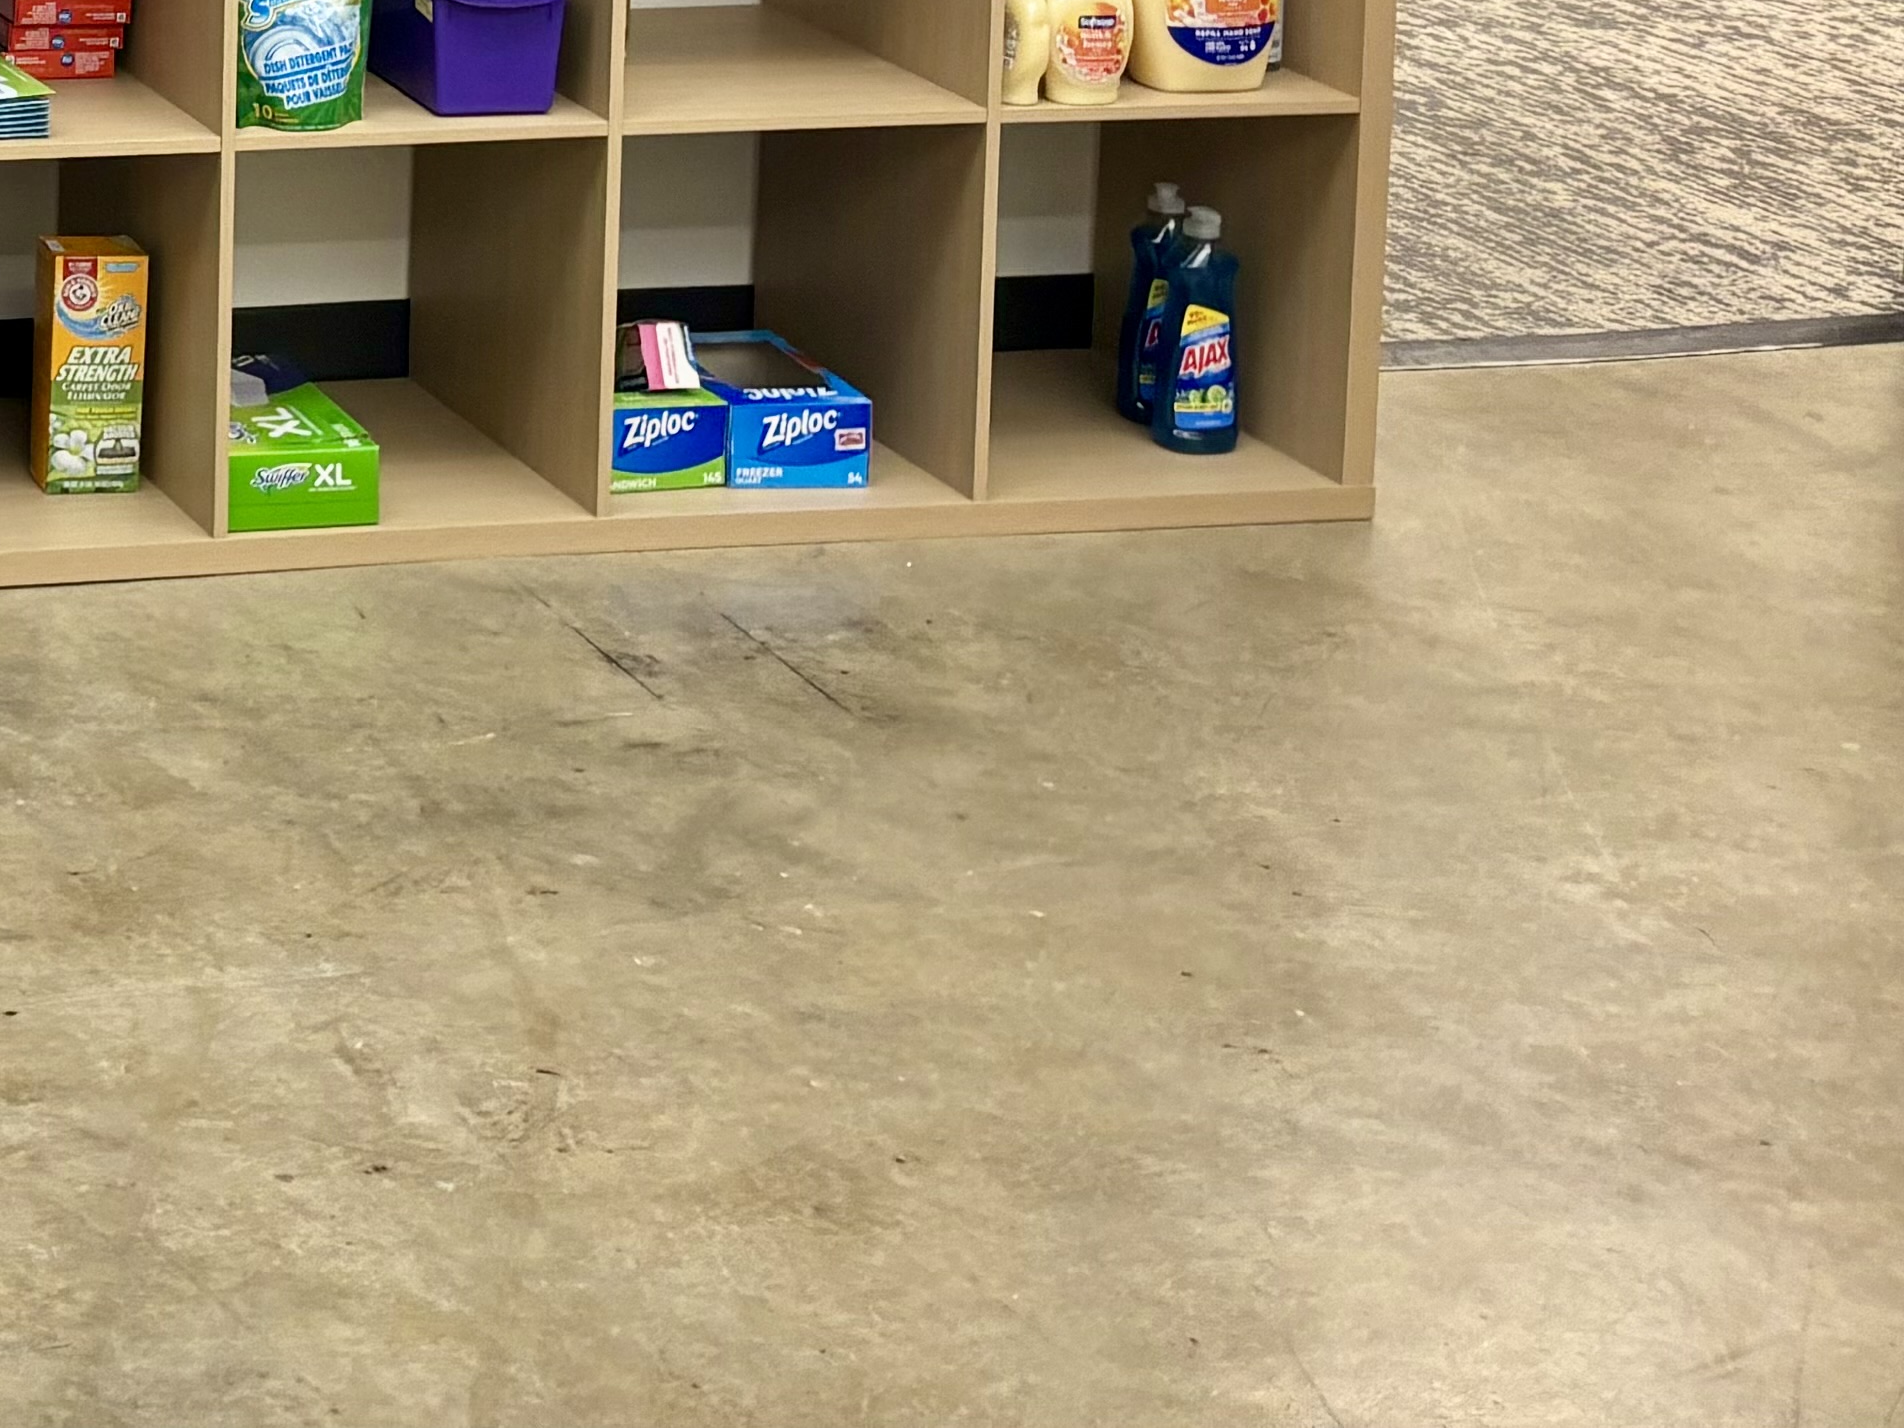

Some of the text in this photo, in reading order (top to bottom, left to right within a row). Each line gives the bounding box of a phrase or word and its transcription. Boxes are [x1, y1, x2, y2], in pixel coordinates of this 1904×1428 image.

[264, 75, 320, 94] PAQUETS DE
[253, 102, 271, 119] 10
[67, 346, 132, 364] EXTRA
[1182, 336, 1229, 373] AJAX
[56, 364, 138, 382] STRENGTH
[62, 381, 131, 392] CARPET ODOR
[623, 410, 696, 448] Ziploc
[762, 409, 837, 448] Ziploc
[254, 462, 352, 490] Swiffer XL
[736, 468, 862, 483] FREEZER 54
